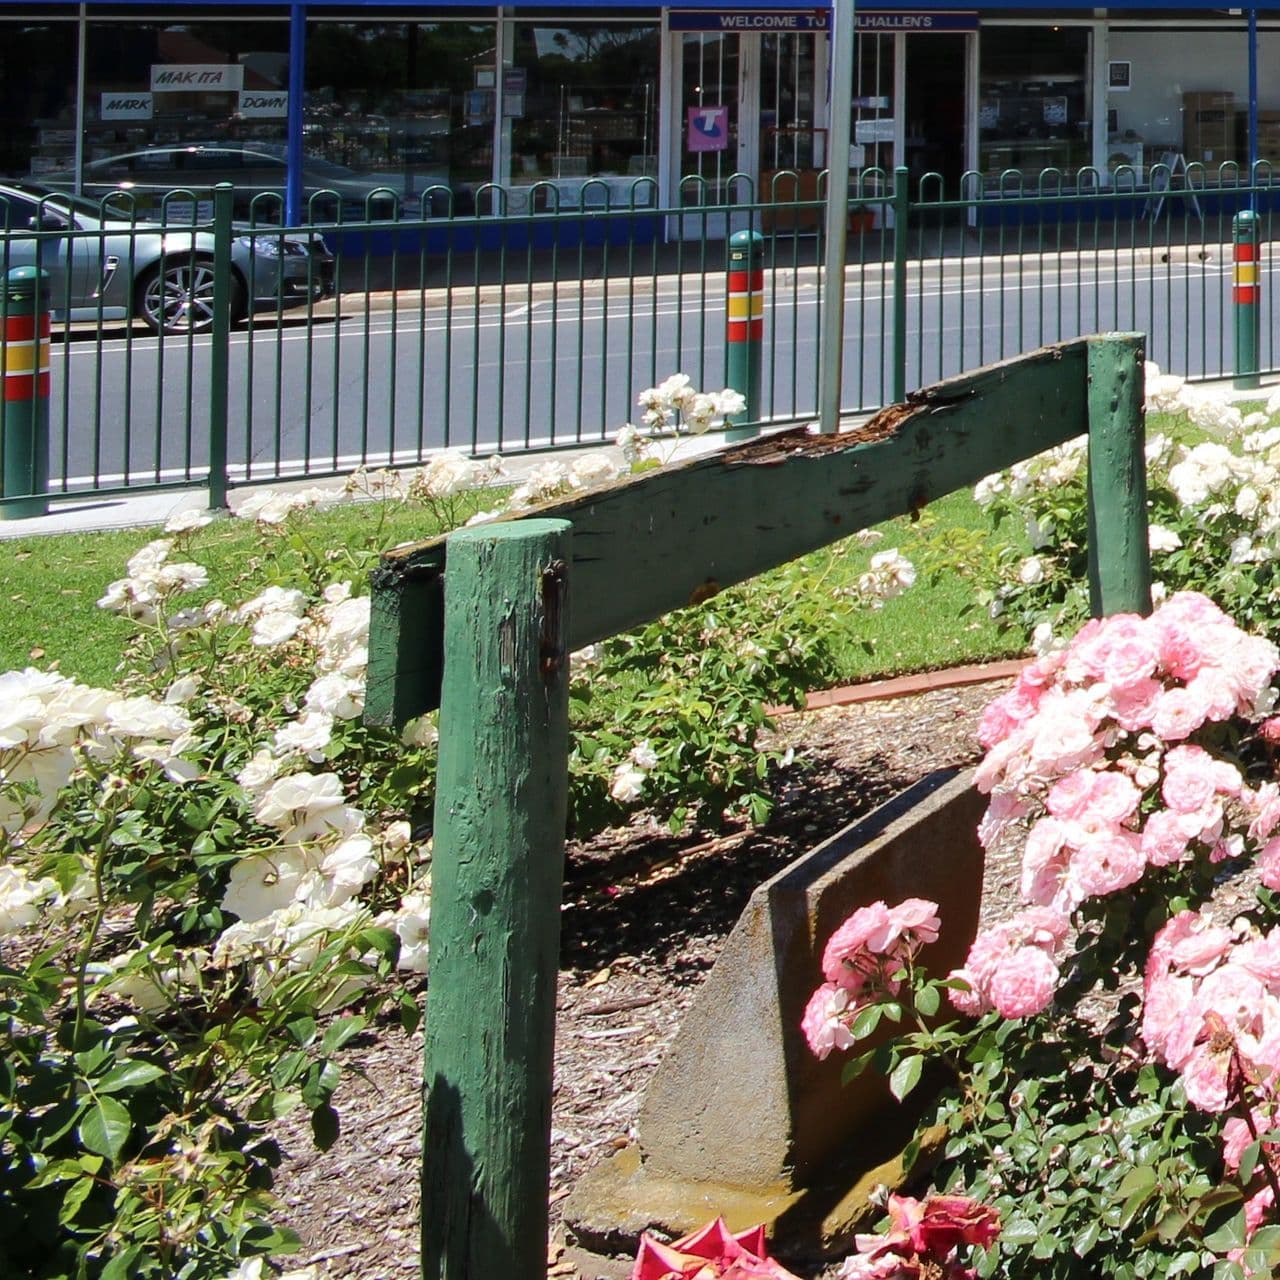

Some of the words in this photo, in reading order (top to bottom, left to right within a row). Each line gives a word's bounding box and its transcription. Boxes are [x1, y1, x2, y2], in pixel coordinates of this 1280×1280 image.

[720, 15, 797, 28] WELCOME
[854, 15, 933, 28] LHALLEN'S
[105, 99, 152, 110] MARK
[242, 97, 287, 109] DOWN
